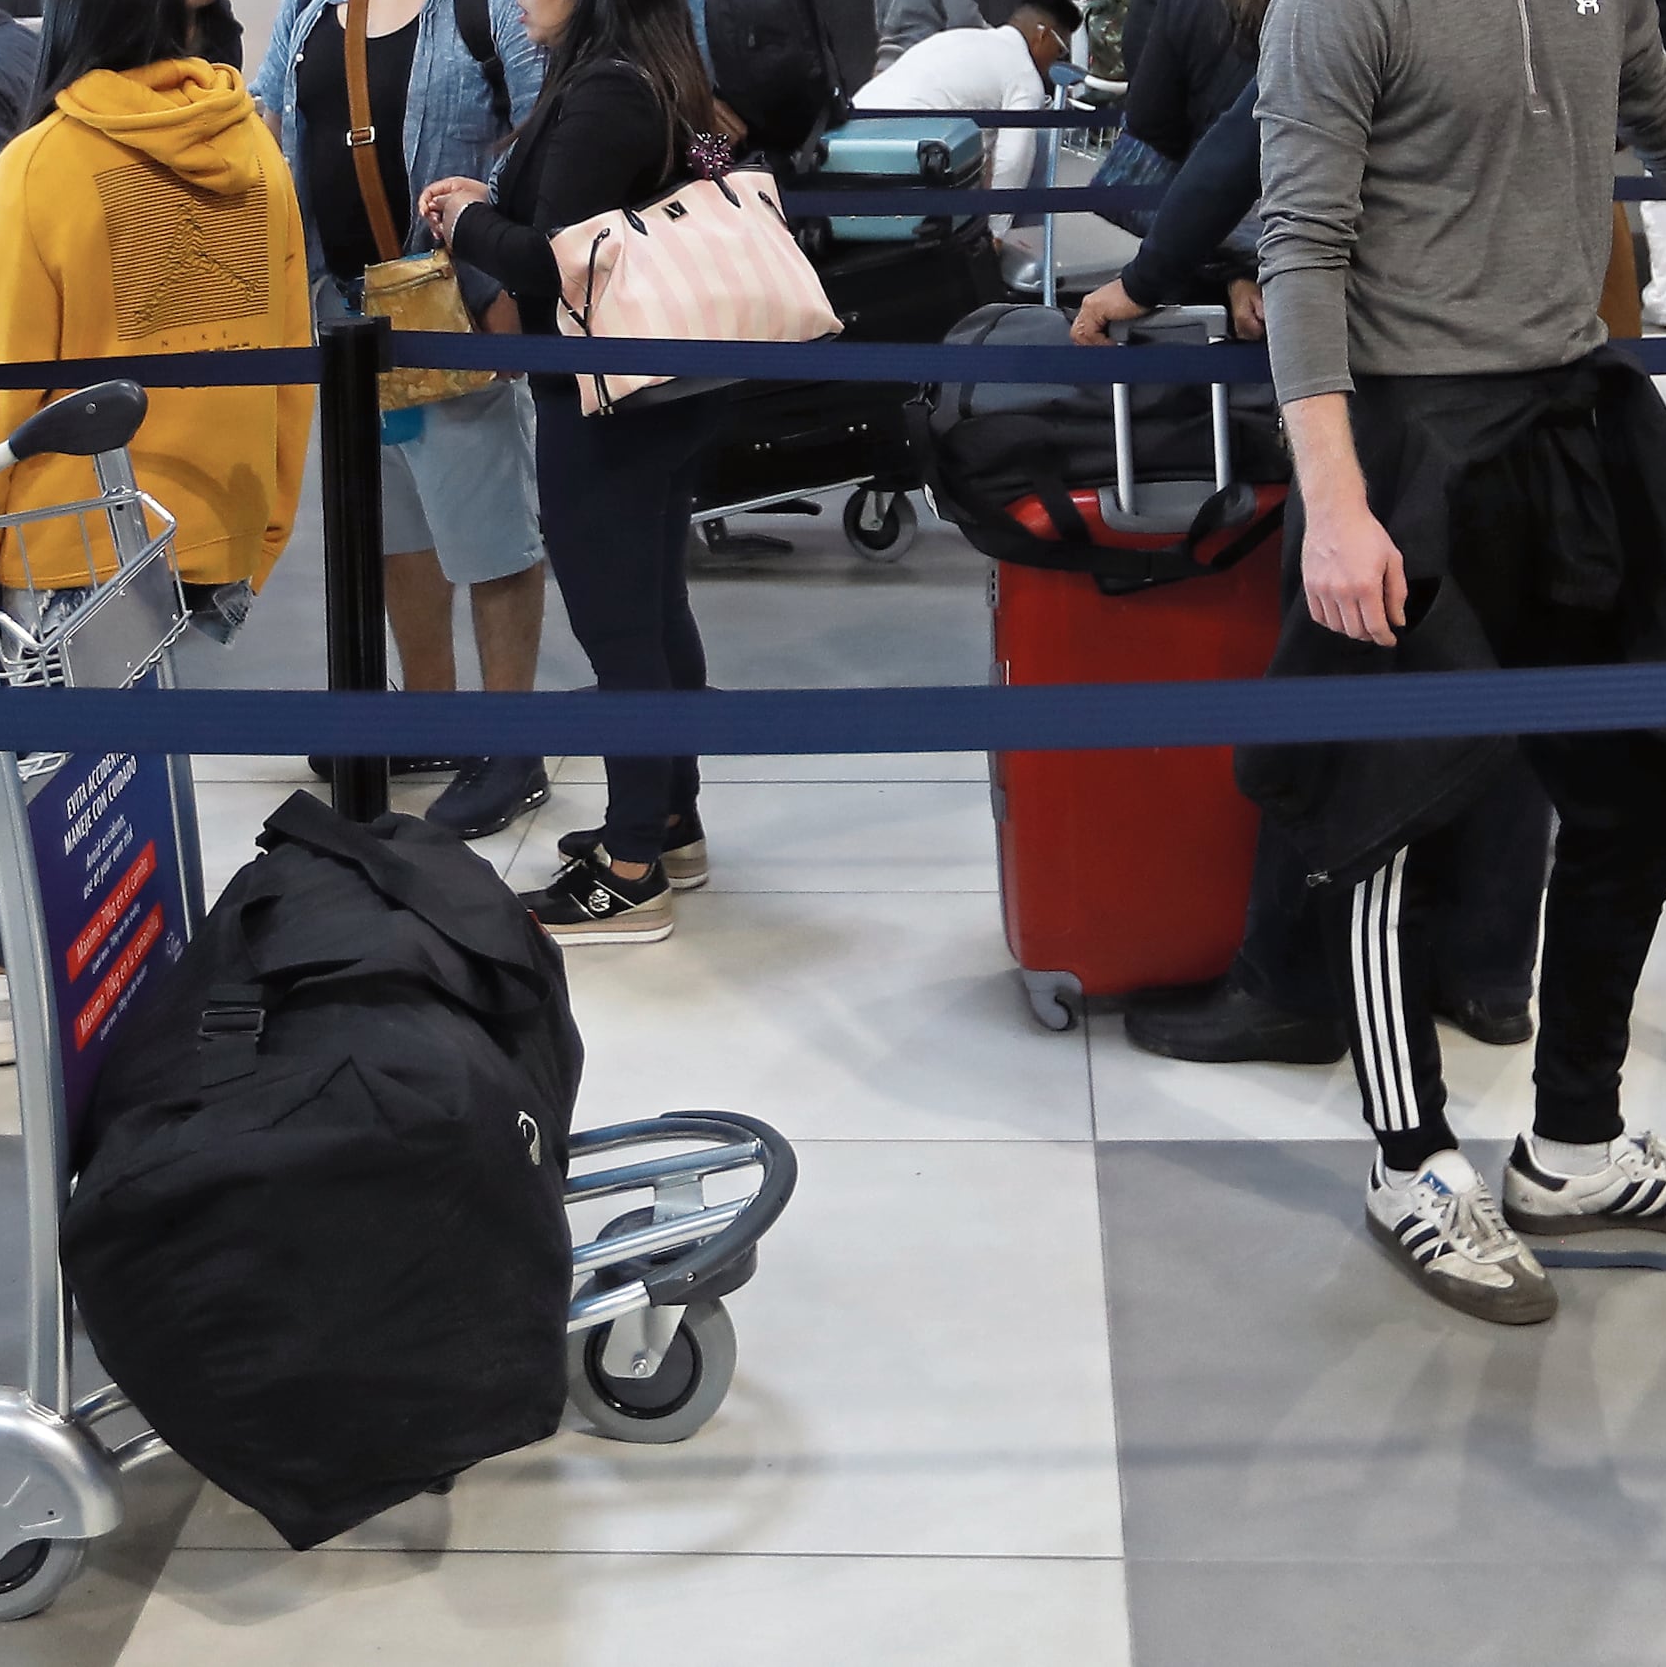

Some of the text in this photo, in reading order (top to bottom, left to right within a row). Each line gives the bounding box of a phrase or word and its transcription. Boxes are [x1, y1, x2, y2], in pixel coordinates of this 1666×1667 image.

[64, 755, 137, 856] MANEJE CON CUIDADO
[67, 782, 88, 820] EVITA
